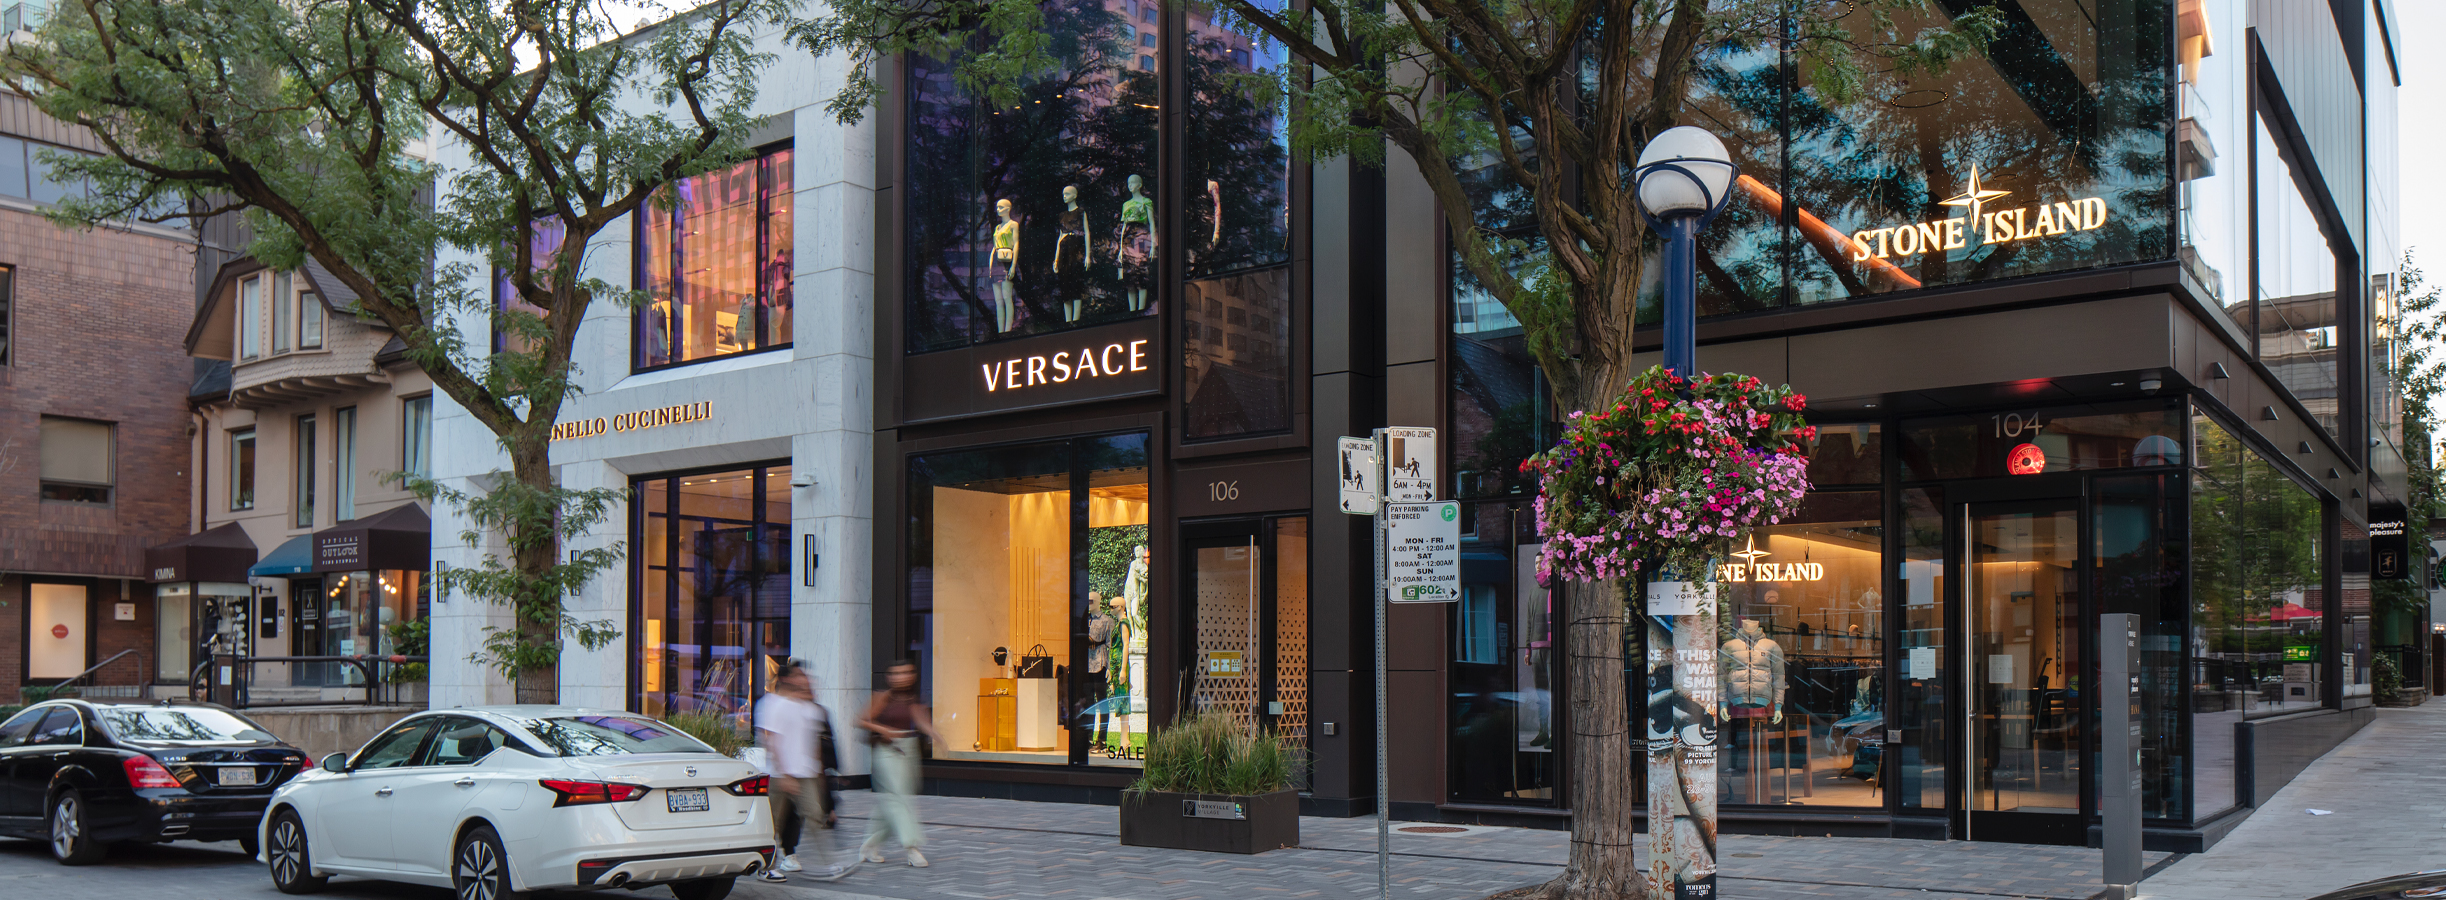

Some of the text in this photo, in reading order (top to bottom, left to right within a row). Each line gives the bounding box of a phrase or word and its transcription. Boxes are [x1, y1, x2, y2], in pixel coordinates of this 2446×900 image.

[1853, 197, 2107, 262] STONE ISLAND
[982, 339, 1148, 392] VERSACE
[549, 401, 712, 442] NELLO CUCINELLI
[1991, 411, 2043, 438] 104
[1392, 429, 1433, 438] LOADING ZONE
[1360, 443, 1374, 452] ZONE
[1208, 480, 1239, 501] 106
[1416, 480, 1431, 489] 4PM
[2369, 520, 2405, 529] majesty's
[2369, 529, 2403, 537] pleasure
[322, 536, 358, 545] OPTICAL
[322, 546, 358, 558] OUTLOOK
[1425, 544, 1443, 552] 12:00
[1428, 574, 1456, 582] 12:00AM
[1716, 562, 1824, 582] NE ISLAND
[1419, 584, 1446, 595] 602
[1677, 649, 1710, 661] THIS
[1686, 663, 1715, 675] WAS
[1107, 745, 1145, 760] SALE
